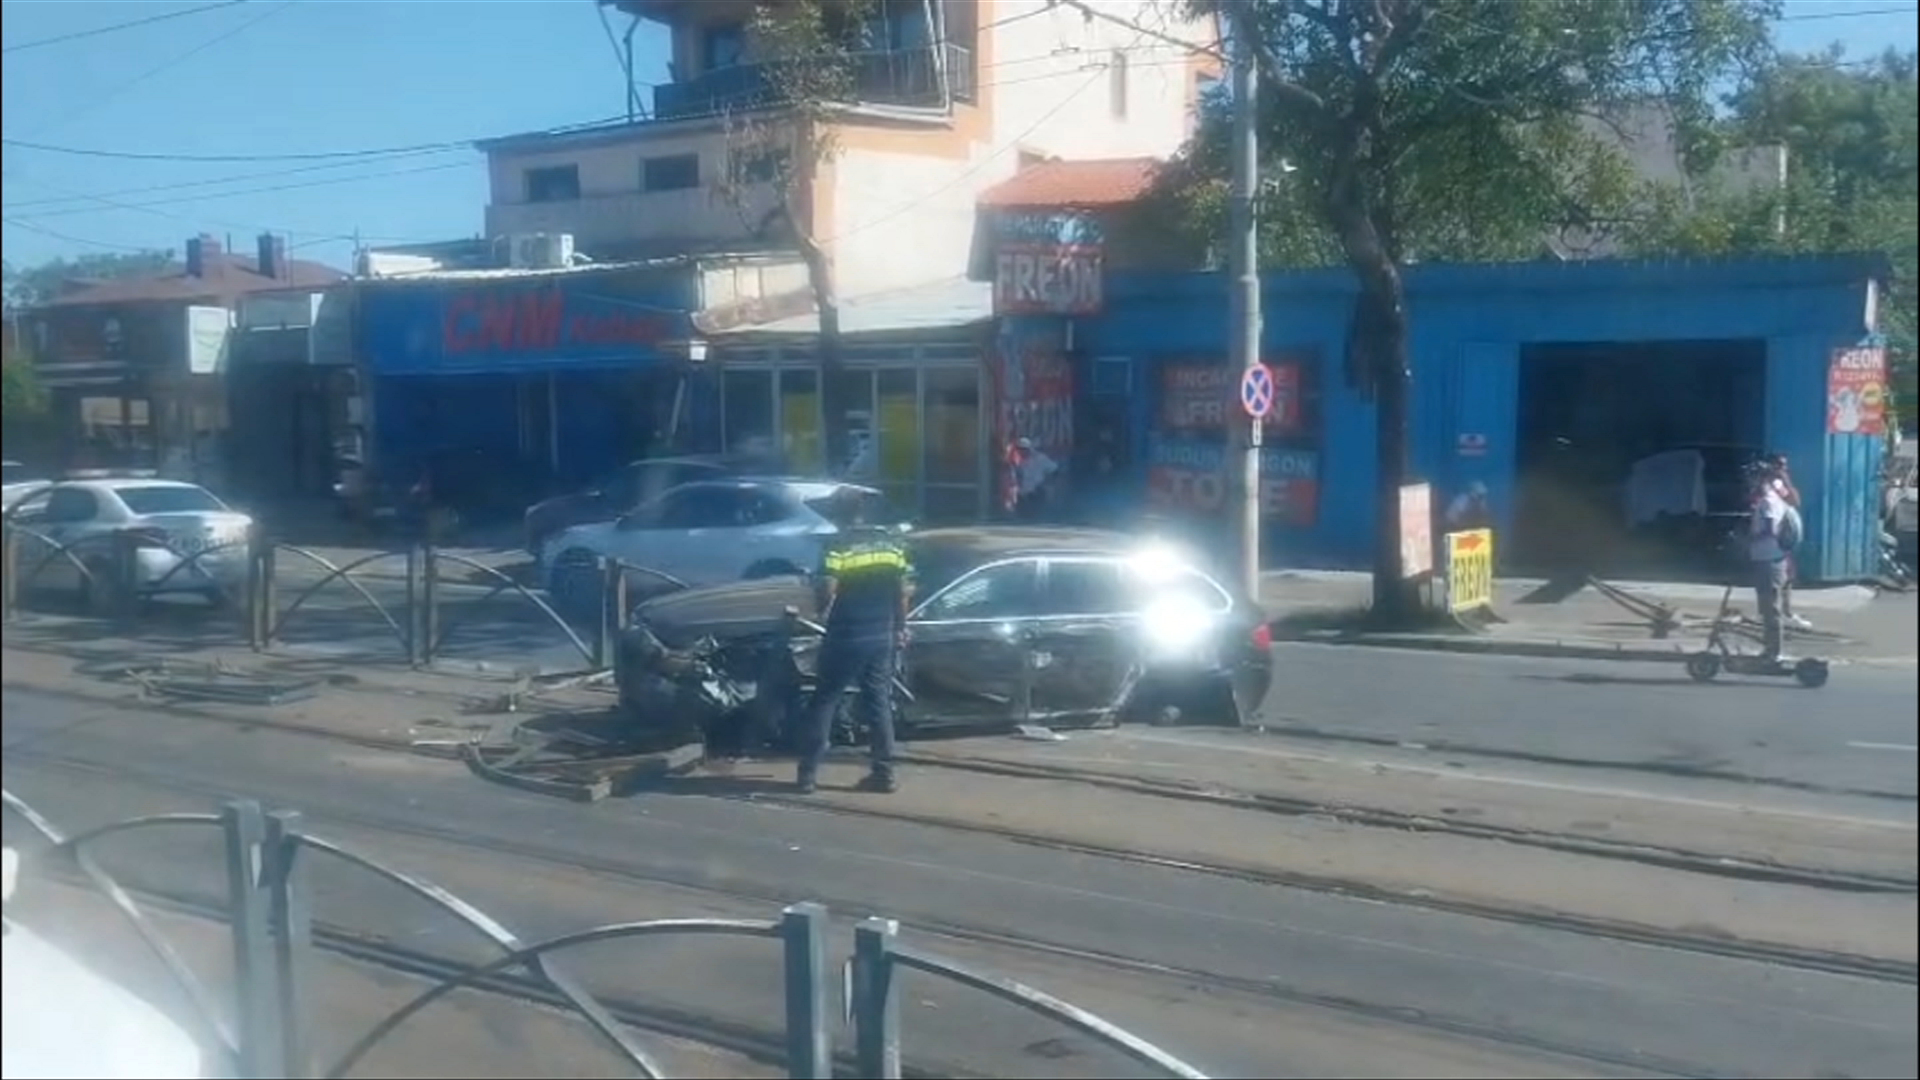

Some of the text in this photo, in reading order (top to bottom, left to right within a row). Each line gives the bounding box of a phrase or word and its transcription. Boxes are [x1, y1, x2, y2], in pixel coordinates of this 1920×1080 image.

[996, 253, 1101, 304] FREON
[1187, 399, 1285, 424] FRN
[1454, 554, 1487, 604] FREON
